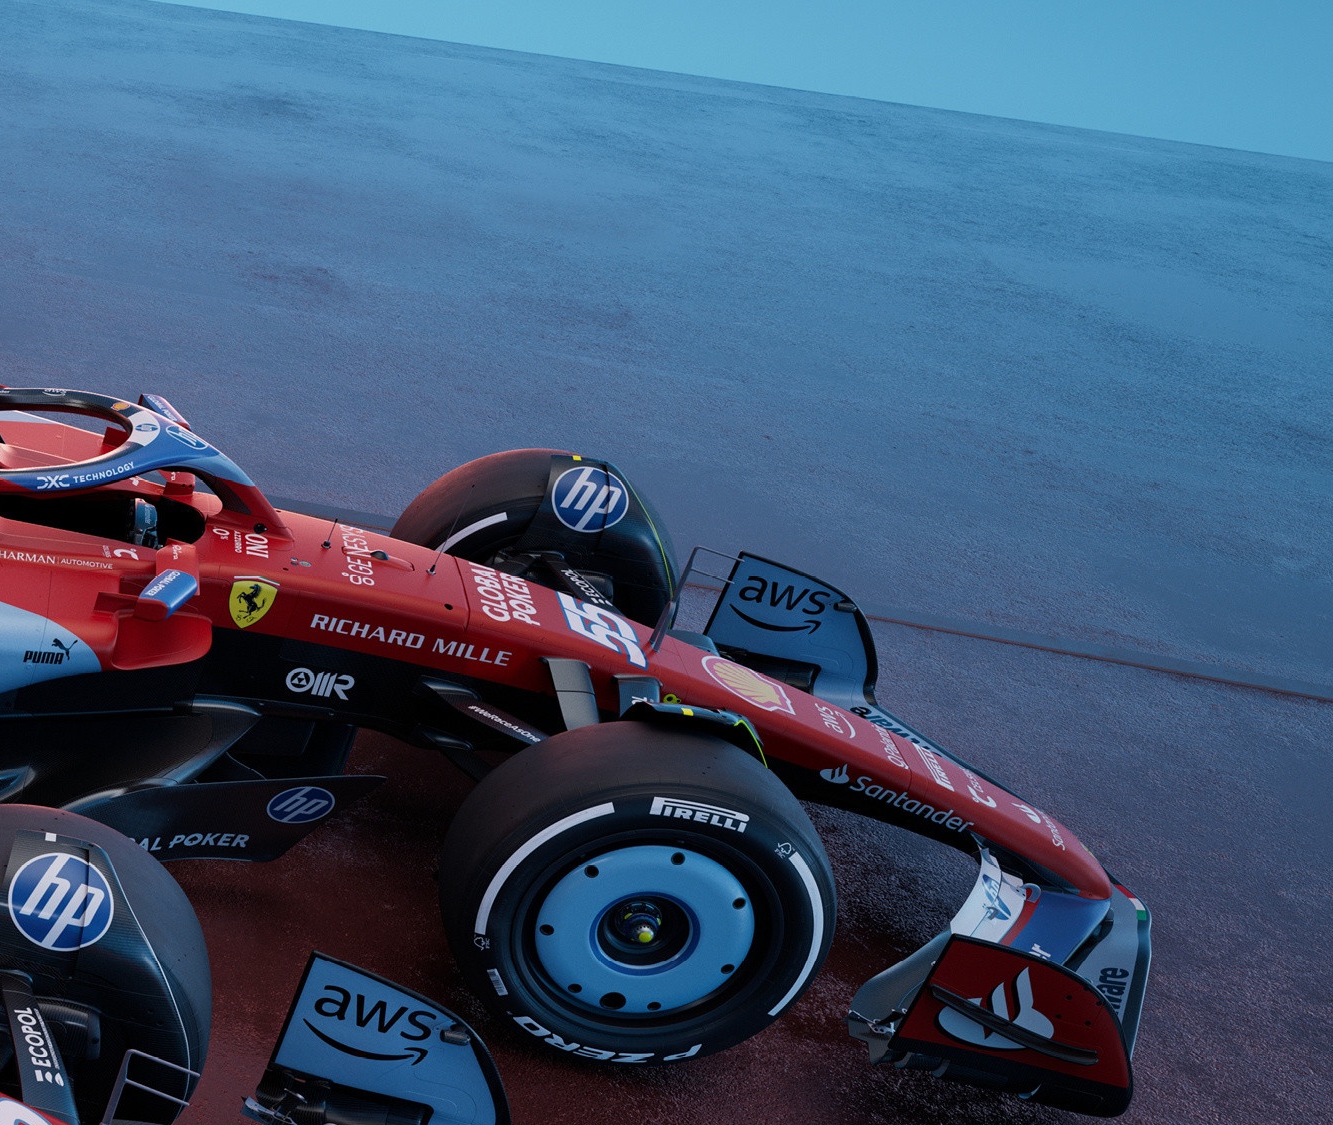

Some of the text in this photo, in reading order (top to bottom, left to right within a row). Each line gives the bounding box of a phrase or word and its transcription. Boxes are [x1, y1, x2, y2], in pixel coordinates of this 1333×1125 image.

[73, 461, 135, 483] TECHNOLOGY
[559, 467, 623, 531] hp
[61, 557, 113, 570] AUTOMOTIVE
[246, 533, 268, 558] ONI
[340, 525, 374, 577] GENESYS
[500, 573, 540, 626] POKER
[737, 575, 834, 616] aws
[310, 614, 512, 667] RICHARD MILLE
[557, 591, 649, 670] 55
[23, 650, 64, 665] PUMA
[272, 787, 330, 823] hp
[649, 796, 750, 833] PIRELLI
[850, 775, 974, 834] Santander
[169, 833, 250, 849] POKER
[17, 853, 107, 951] hp
[14, 1007, 51, 1068] ECOPOL
[314, 985, 437, 1041] aws
[512, 1016, 702, 1064] P ZERO
